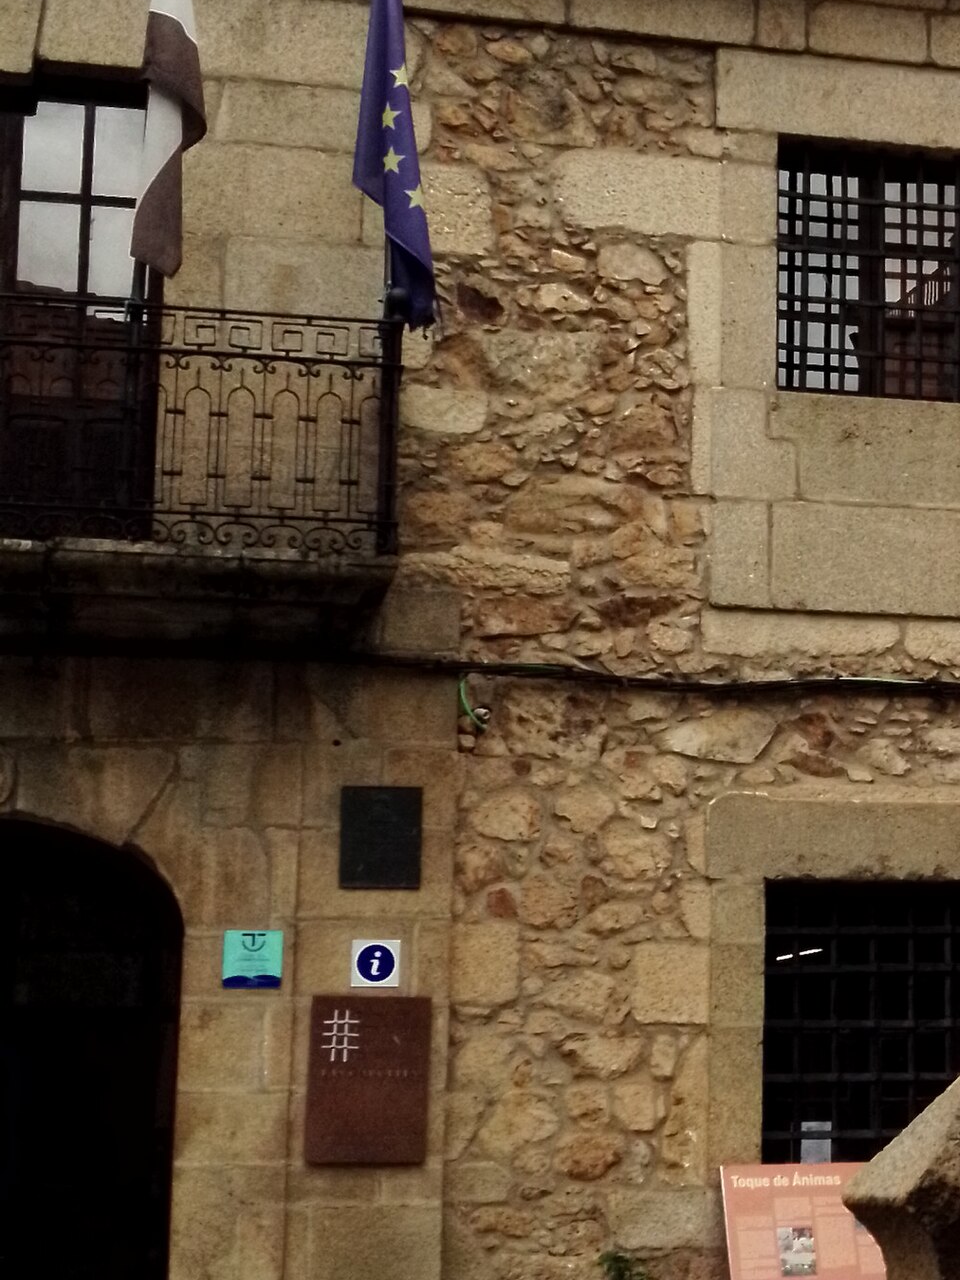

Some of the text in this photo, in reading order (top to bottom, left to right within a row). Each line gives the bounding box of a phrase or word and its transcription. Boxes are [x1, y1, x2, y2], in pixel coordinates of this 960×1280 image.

[730, 1172, 842, 1189] Toque de Ánimas
